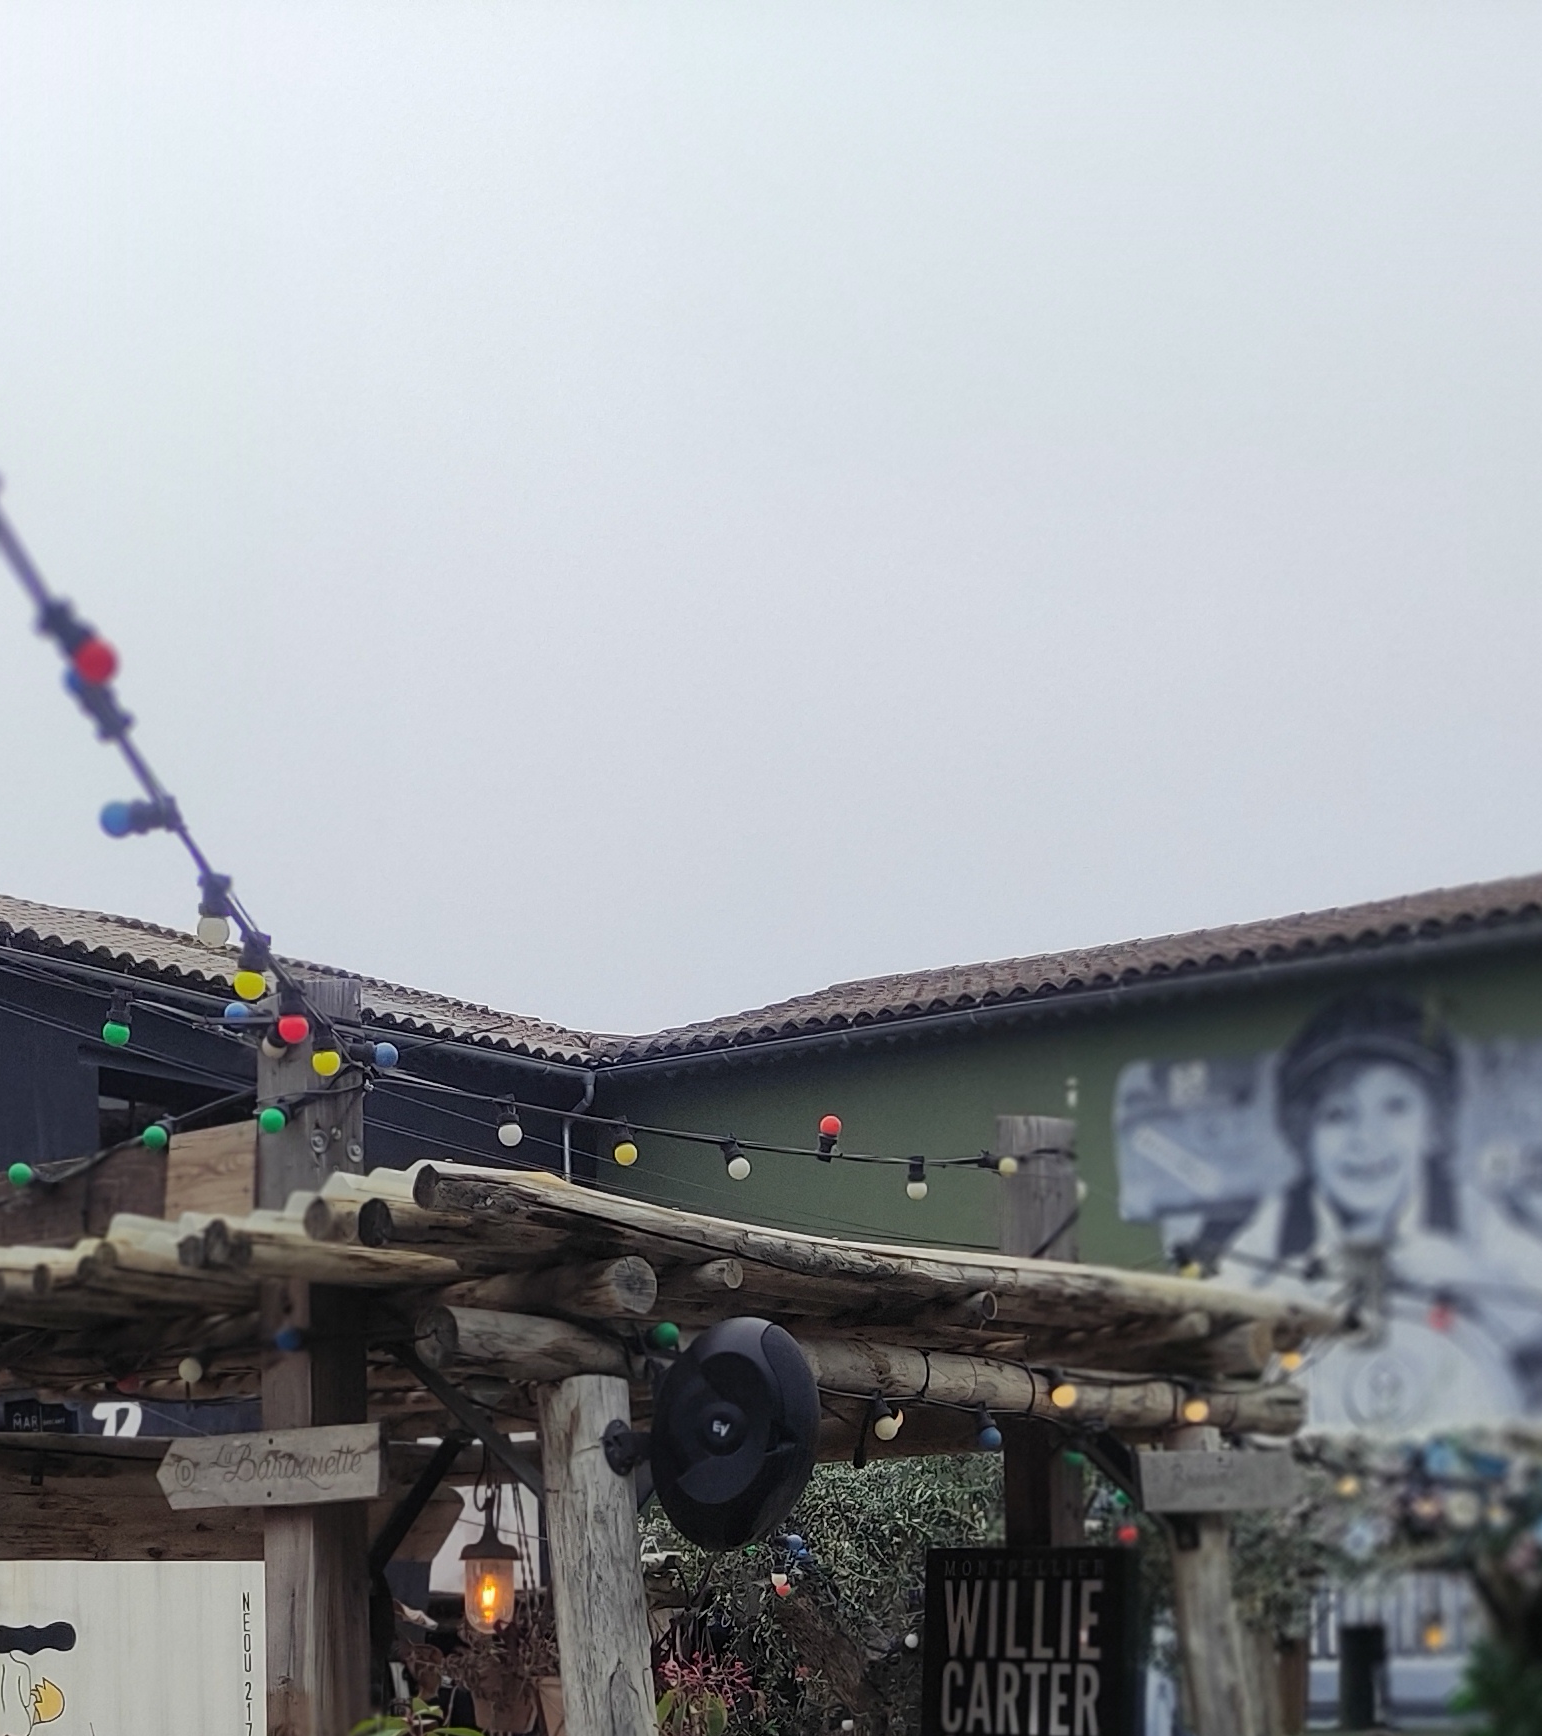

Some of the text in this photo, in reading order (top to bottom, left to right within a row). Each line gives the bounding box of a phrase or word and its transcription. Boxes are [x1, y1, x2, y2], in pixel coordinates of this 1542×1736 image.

[712, 1420, 731, 1437] EV
[944, 1559, 1106, 1577] MONTPELLIER
[241, 1591, 253, 1673] NEOU
[945, 1579, 1104, 1660] WILLIE
